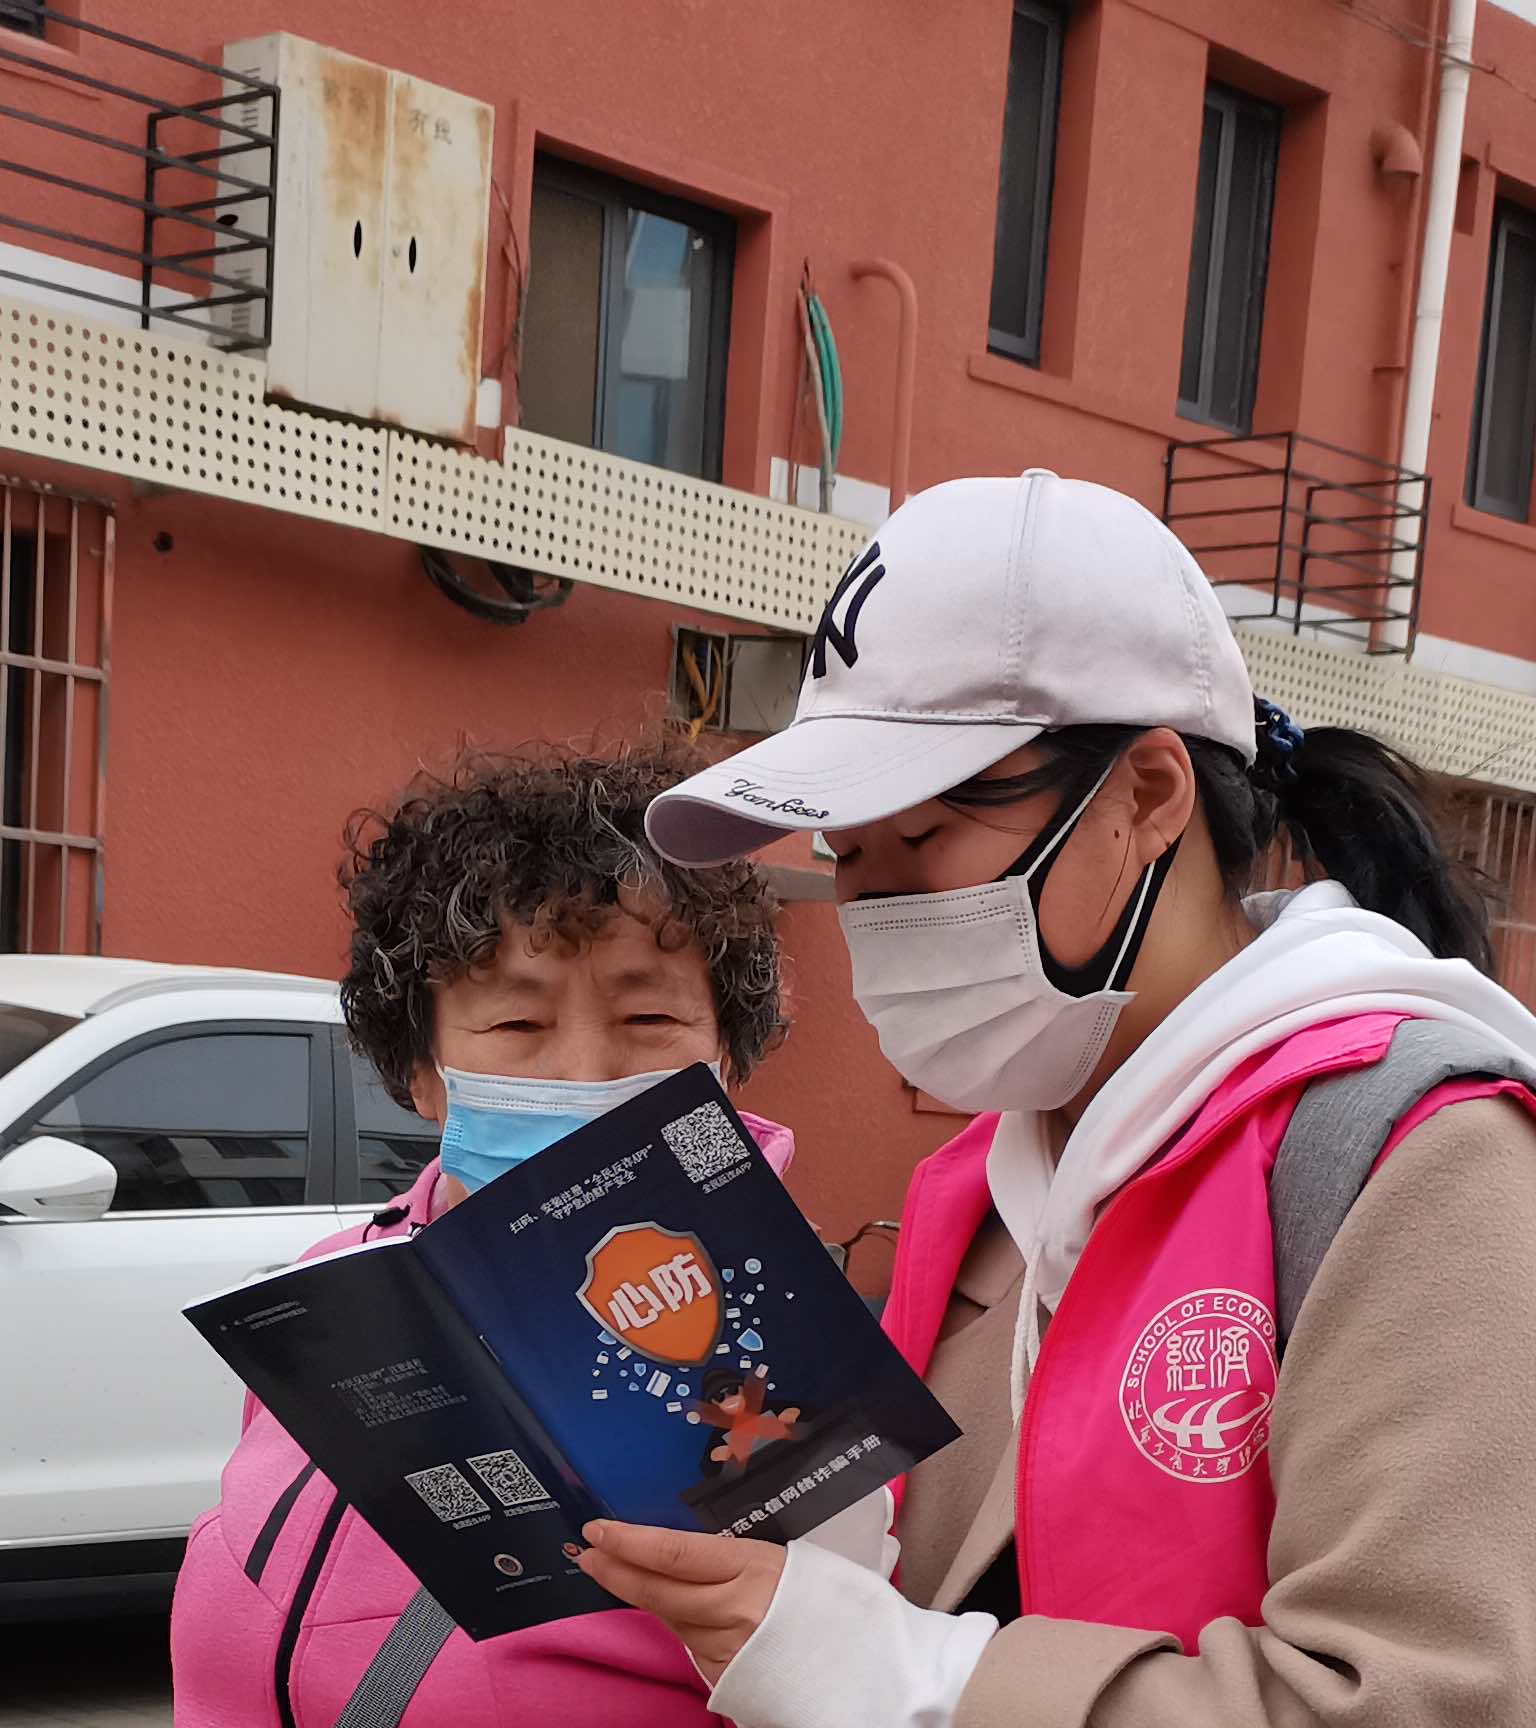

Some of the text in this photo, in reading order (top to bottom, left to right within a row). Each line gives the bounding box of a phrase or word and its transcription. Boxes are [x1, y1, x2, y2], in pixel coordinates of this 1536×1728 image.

[724, 779, 829, 818] Yankees
[607, 1252, 713, 1332] 心防
[1127, 1315, 1178, 1388] SCHOOL
[1180, 1298, 1205, 1318] OF
